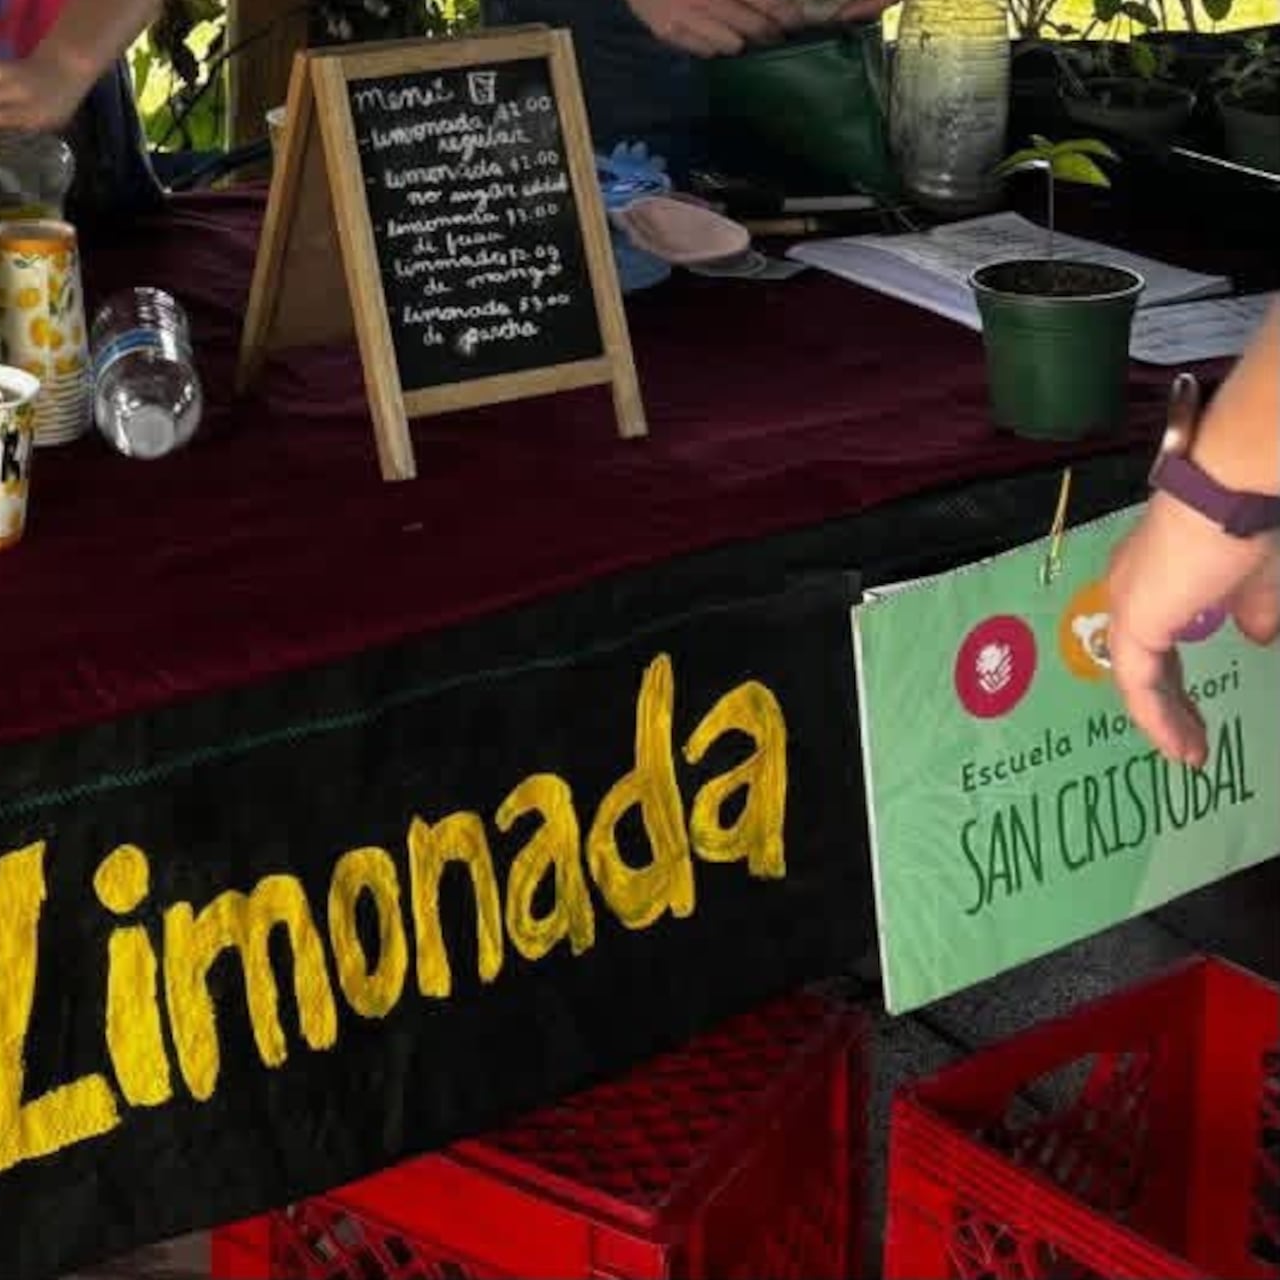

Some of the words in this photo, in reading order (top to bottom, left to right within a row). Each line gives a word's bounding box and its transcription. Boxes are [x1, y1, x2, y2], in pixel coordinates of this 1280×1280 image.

[960, 728, 1073, 794] Escuela
[1086, 659, 1239, 751] Mosori
[959, 801, 1046, 917] SAN
